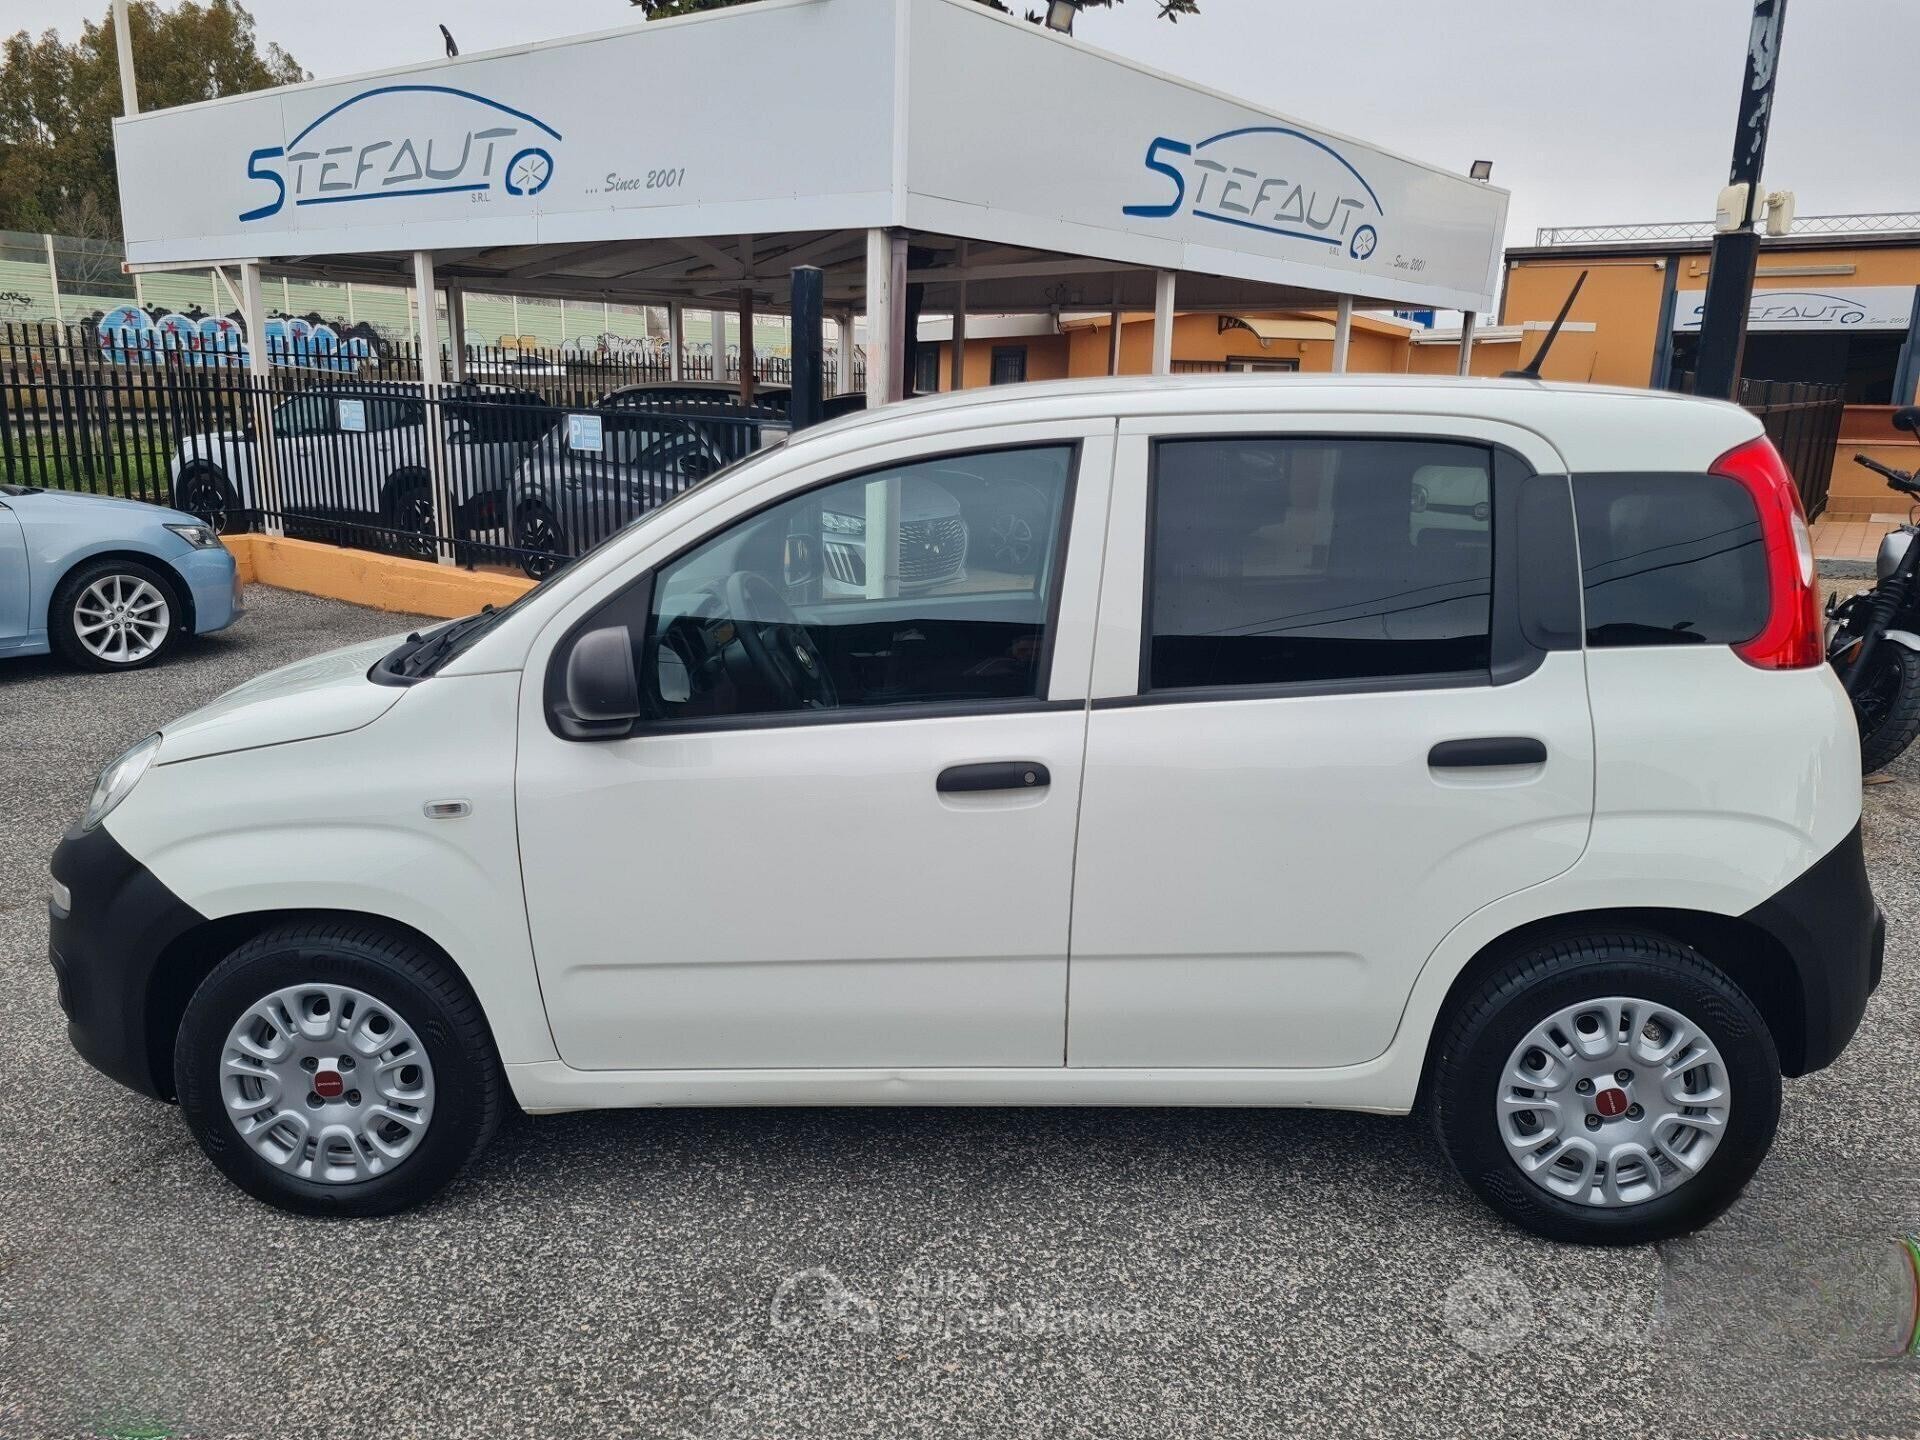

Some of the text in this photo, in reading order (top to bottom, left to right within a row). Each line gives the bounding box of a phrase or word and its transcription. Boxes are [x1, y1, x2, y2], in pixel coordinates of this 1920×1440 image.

[238, 127, 555, 223] STEFAUTO
[604, 172, 640, 192] Since
[646, 168, 686, 189] 2001
[1122, 136, 1378, 261] STEFAUTO
